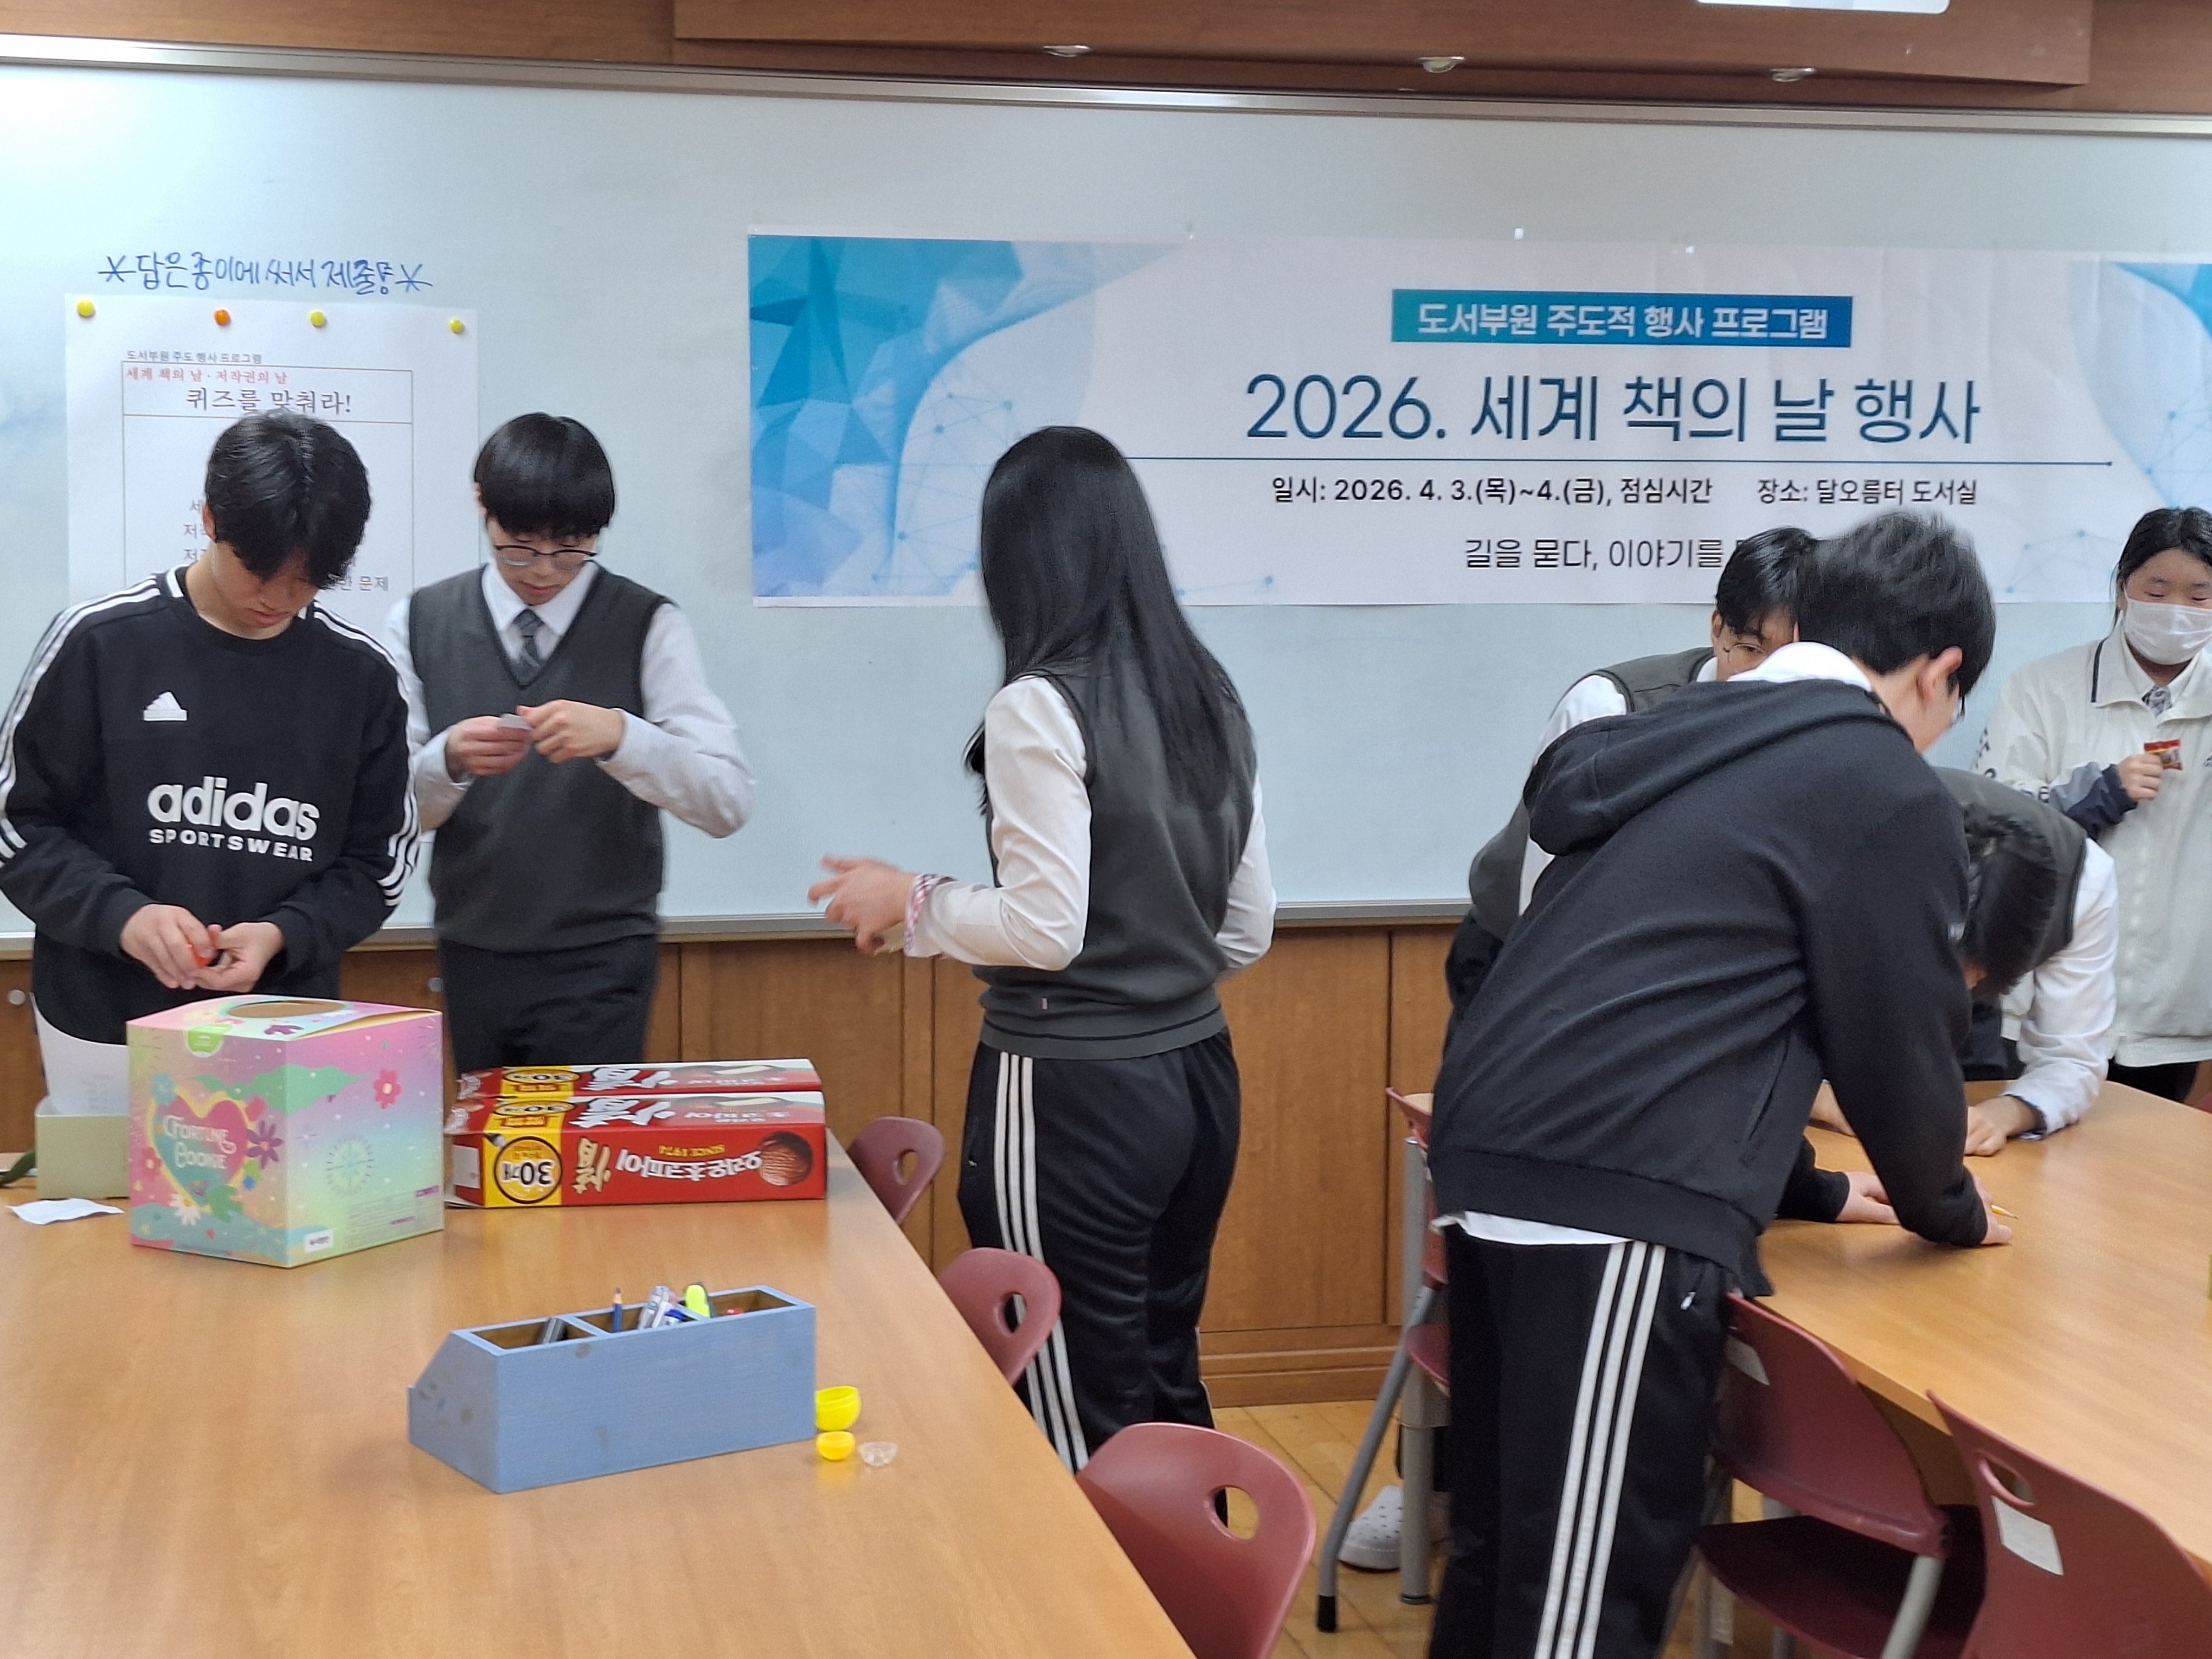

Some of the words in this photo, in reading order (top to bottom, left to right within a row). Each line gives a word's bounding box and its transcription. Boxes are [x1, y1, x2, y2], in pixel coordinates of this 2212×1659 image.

[265, 259, 316, 287] 써서
[1418, 303, 1538, 336] 도서부원
[1547, 304, 1636, 337] 주도적
[1644, 306, 1705, 338] 행사
[1711, 307, 1829, 340] 프로그램
[127, 350, 169, 362] 도서부원
[172, 351, 193, 362] 주도
[221, 353, 262, 364] 프로그램
[127, 367, 152, 380] 세계
[187, 387, 261, 411] 퀴즈를
[271, 389, 351, 414] 맞춰라!
[1246, 374, 1446, 440] 2026.
[1470, 375, 1599, 441] 세계
[1623, 376, 1747, 443] 책의
[1774, 378, 1835, 443] 날
[1855, 378, 1982, 445] 행사
[1272, 476, 1326, 504] 일시:
[1334, 479, 1411, 500] 2026.
[1419, 479, 1442, 500] 4.
[1621, 478, 1713, 505] 점심시간
[1758, 478, 1809, 505] 장소:
[1817, 478, 1904, 505] 달오름터
[1912, 479, 1977, 505] 도서실
[1465, 538, 1522, 568] 길을
[1533, 538, 1597, 571] 묻다,
[1609, 538, 1724, 568] 이야기를
[359, 576, 389, 591] 문제
[147, 775, 320, 840] adidas
[149, 828, 313, 862] SPORTSWEAR
[500, 1159, 555, 1188] 30개
